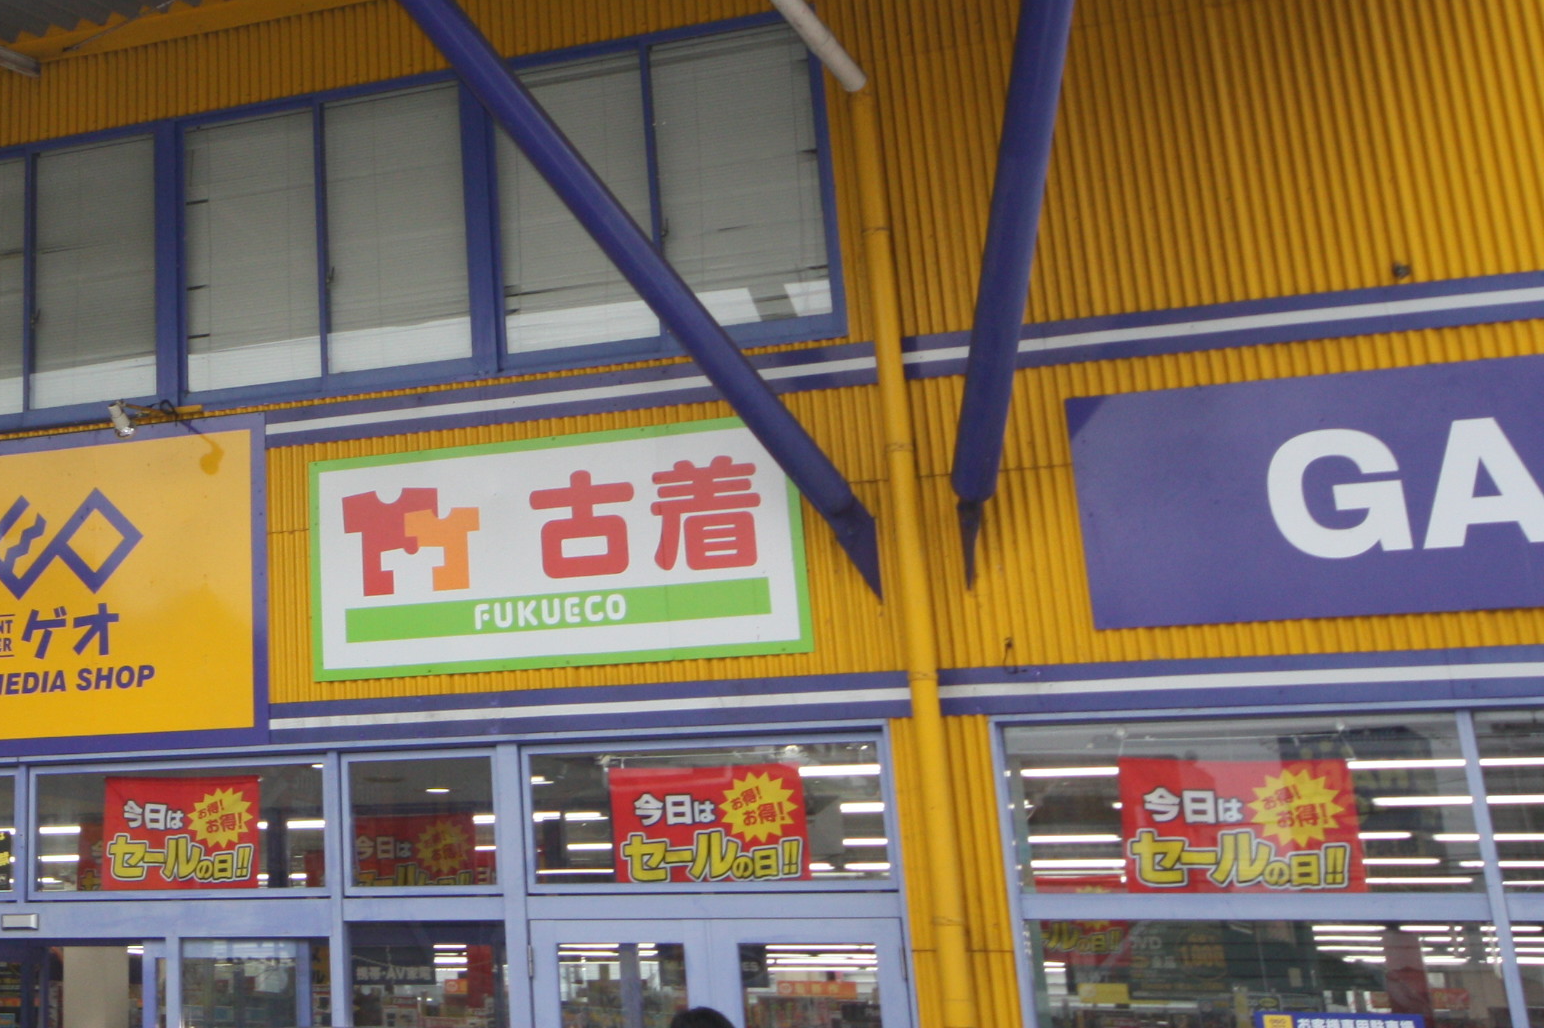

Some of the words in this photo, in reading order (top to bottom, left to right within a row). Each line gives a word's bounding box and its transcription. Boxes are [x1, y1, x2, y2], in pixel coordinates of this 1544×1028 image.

[1266, 417, 1544, 560] GA
[529, 455, 761, 579] 古着
[474, 594, 627, 630] FUKUECO
[21, 602, 120, 660] ゲオ
[76, 664, 156, 691] SHOP
[634, 793, 715, 826] 今日は
[730, 786, 762, 811] お得!
[743, 801, 786, 826] お得!
[1143, 787, 1243, 824] 今日は
[1262, 784, 1302, 811] お得!
[124, 800, 184, 830] 今日は
[207, 813, 243, 834] お得!
[1277, 802, 1330, 829] お得!
[108, 833, 254, 881] セールの日!!
[356, 836, 412, 860] 今日は
[620, 828, 802, 883] セールの日!!
[1127, 828, 1350, 889] セールの日!!
